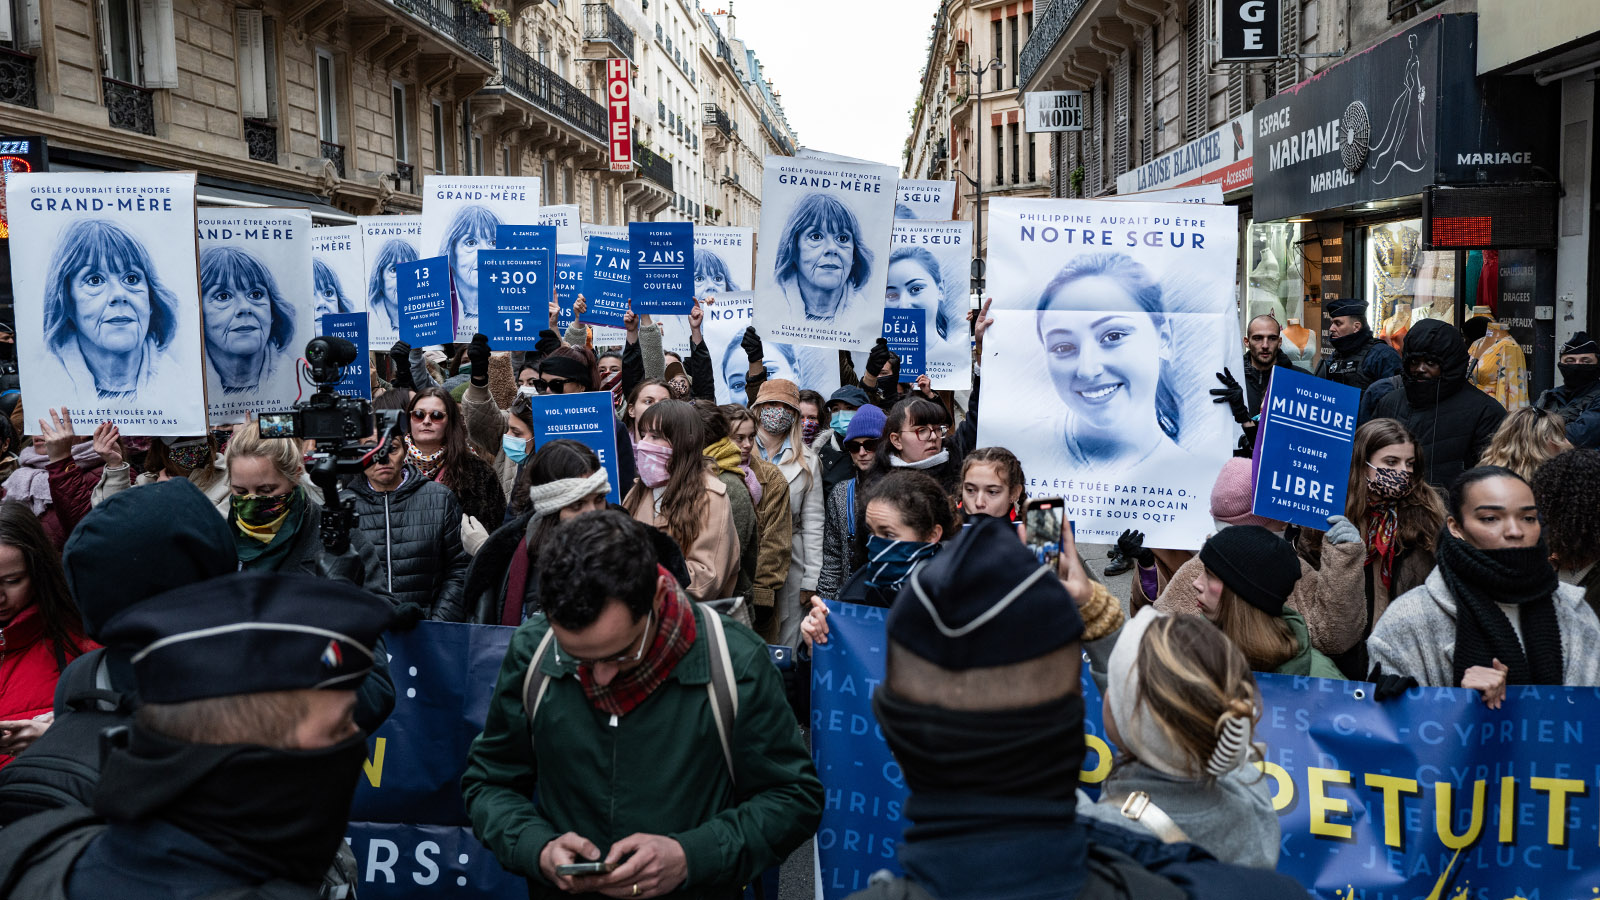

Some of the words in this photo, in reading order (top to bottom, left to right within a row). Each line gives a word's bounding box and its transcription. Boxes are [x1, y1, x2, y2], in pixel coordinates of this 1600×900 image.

[609, 59, 629, 161] HOTEL
[1039, 109, 1082, 128] MODE
[1259, 106, 1291, 138] ESPACE
[0, 141, 29, 154] ZZA
[1269, 118, 1341, 172] MARIAME
[1137, 169, 1147, 192] LA
[1148, 154, 1171, 188] ROSE
[1174, 131, 1221, 178] BLANCHE
[1457, 151, 1532, 165] MARIAGE
[805, 169, 839, 177] POURRAIT
[841, 170, 857, 178] ÊTRE
[778, 174, 881, 193] GRAND-MÈRE
[1310, 169, 1355, 194] MARIAGE
[30, 186, 62, 194] GISÈLE
[115, 185, 138, 194] ÊTRE
[437, 189, 526, 201] GRAND-MÈRE
[30, 194, 172, 211] GRAND-MÈRE
[904, 193, 941, 203] SŒUR
[243, 217, 263, 226] ÊTRE
[1020, 213, 1092, 224] PHILIPPINE
[1100, 216, 1148, 225] AURAIT
[1154, 218, 1170, 226] PU
[1175, 216, 1206, 228] ÊTRE
[197, 225, 293, 240] AND-MÈRE
[367, 225, 422, 235] GRAND-MÈ
[945, 226, 962, 234] ÊTRE
[893, 234, 917, 244] TRE
[922, 234, 961, 245] SŒUR
[1020, 226, 1113, 246] NOTRE
[1126, 230, 1205, 249] SŒUR
[595, 254, 603, 266] 7
[608, 256, 630, 271] AN
[637, 250, 647, 263] 2
[652, 250, 685, 263] ANS
[414, 267, 429, 280] 13
[489, 271, 537, 285] +300
[594, 270, 631, 281] SEULEMEN
[1500, 266, 1534, 277] CHAUSSURES
[416, 280, 430, 288] ANS
[643, 282, 682, 290] COUTEAU
[1503, 292, 1531, 302] DRAGEES
[403, 300, 445, 312] PÉDOPHILES
[594, 299, 628, 309] MEURTRE
[711, 308, 753, 320] NOTR
[503, 318, 524, 332] 15
[884, 320, 918, 334] DÉJÀ
[781, 331, 808, 339] HOMMES
[1296, 387, 1312, 398] VIOL
[1314, 392, 1336, 404] D'UNE
[114, 408, 144, 416] VIOLÉE
[564, 407, 599, 415] VIOLENCE,
[1271, 395, 1355, 431] MINEURE
[547, 423, 599, 432] SEQUESTRATION
[1288, 443, 1295, 451] L.
[1297, 446, 1328, 459] CURNIER
[1293, 460, 1302, 468] 53
[1303, 463, 1319, 473] ANS,
[1053, 478, 1074, 489] ÉTÉ
[1079, 480, 1110, 492] TUÉE
[1115, 484, 1138, 495] PAR
[1142, 486, 1174, 497] TAHA
[1271, 471, 1335, 504] LIBRE
[1120, 499, 1189, 511] MAROCAIN
[1277, 498, 1292, 507] ANS
[1293, 502, 1310, 512] PLUS
[1311, 506, 1330, 516] TARD
[1106, 510, 1138, 520] SOUS
[1142, 512, 1177, 524] OQTF
